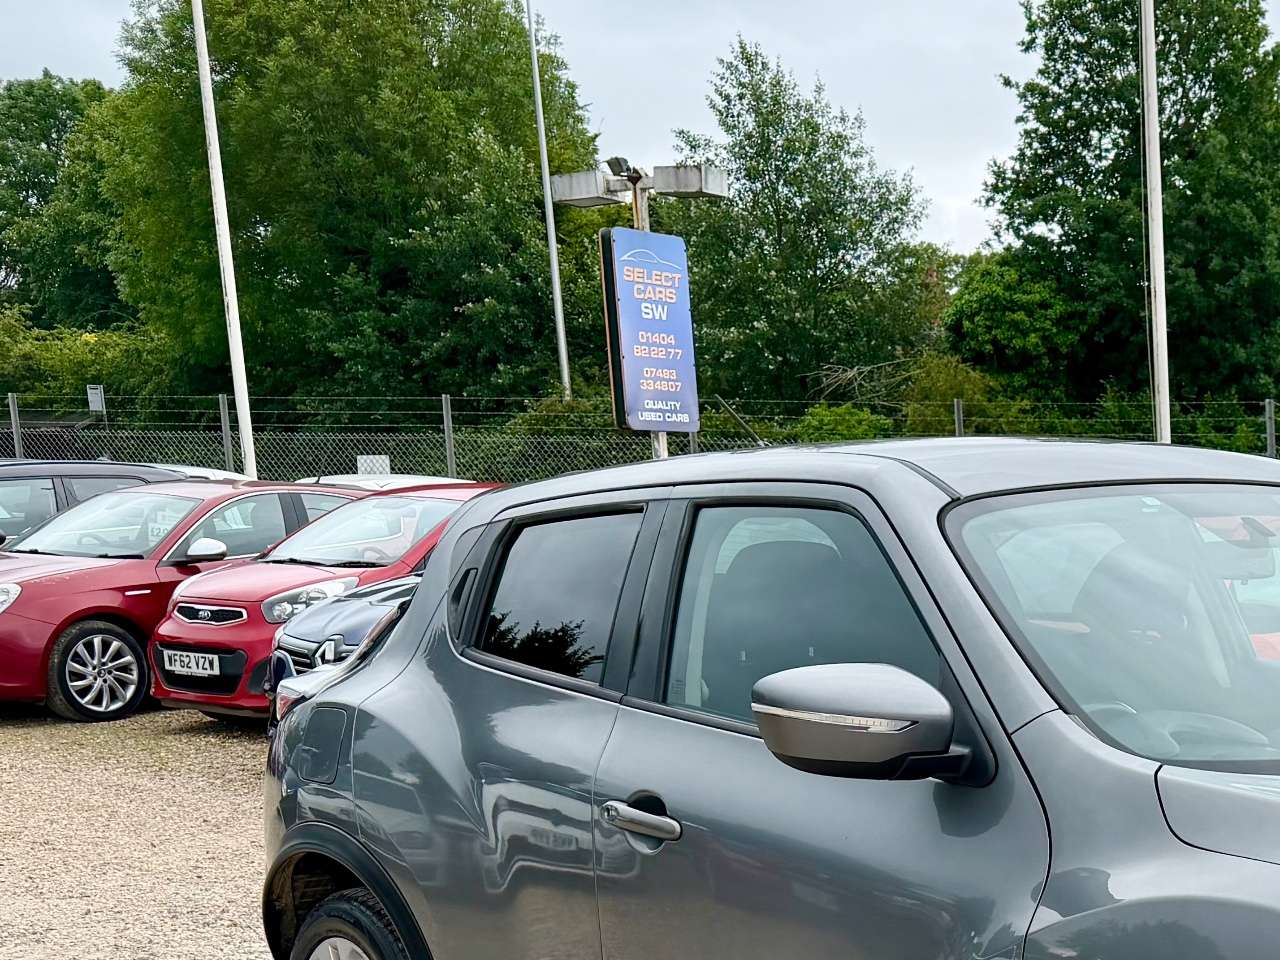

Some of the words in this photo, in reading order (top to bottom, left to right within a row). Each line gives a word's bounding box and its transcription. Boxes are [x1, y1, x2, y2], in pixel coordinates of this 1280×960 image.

[624, 266, 682, 288] SELECT
[634, 284, 677, 303] CARS
[641, 302, 668, 321] SW
[639, 331, 675, 346] 01404
[640, 379, 682, 391] 334807
[644, 400, 681, 411] QUALITY
[638, 411, 663, 421] USED
[665, 413, 690, 423] CARS
[167, 652, 192, 670] WF62
[193, 654, 215, 672] VZW
